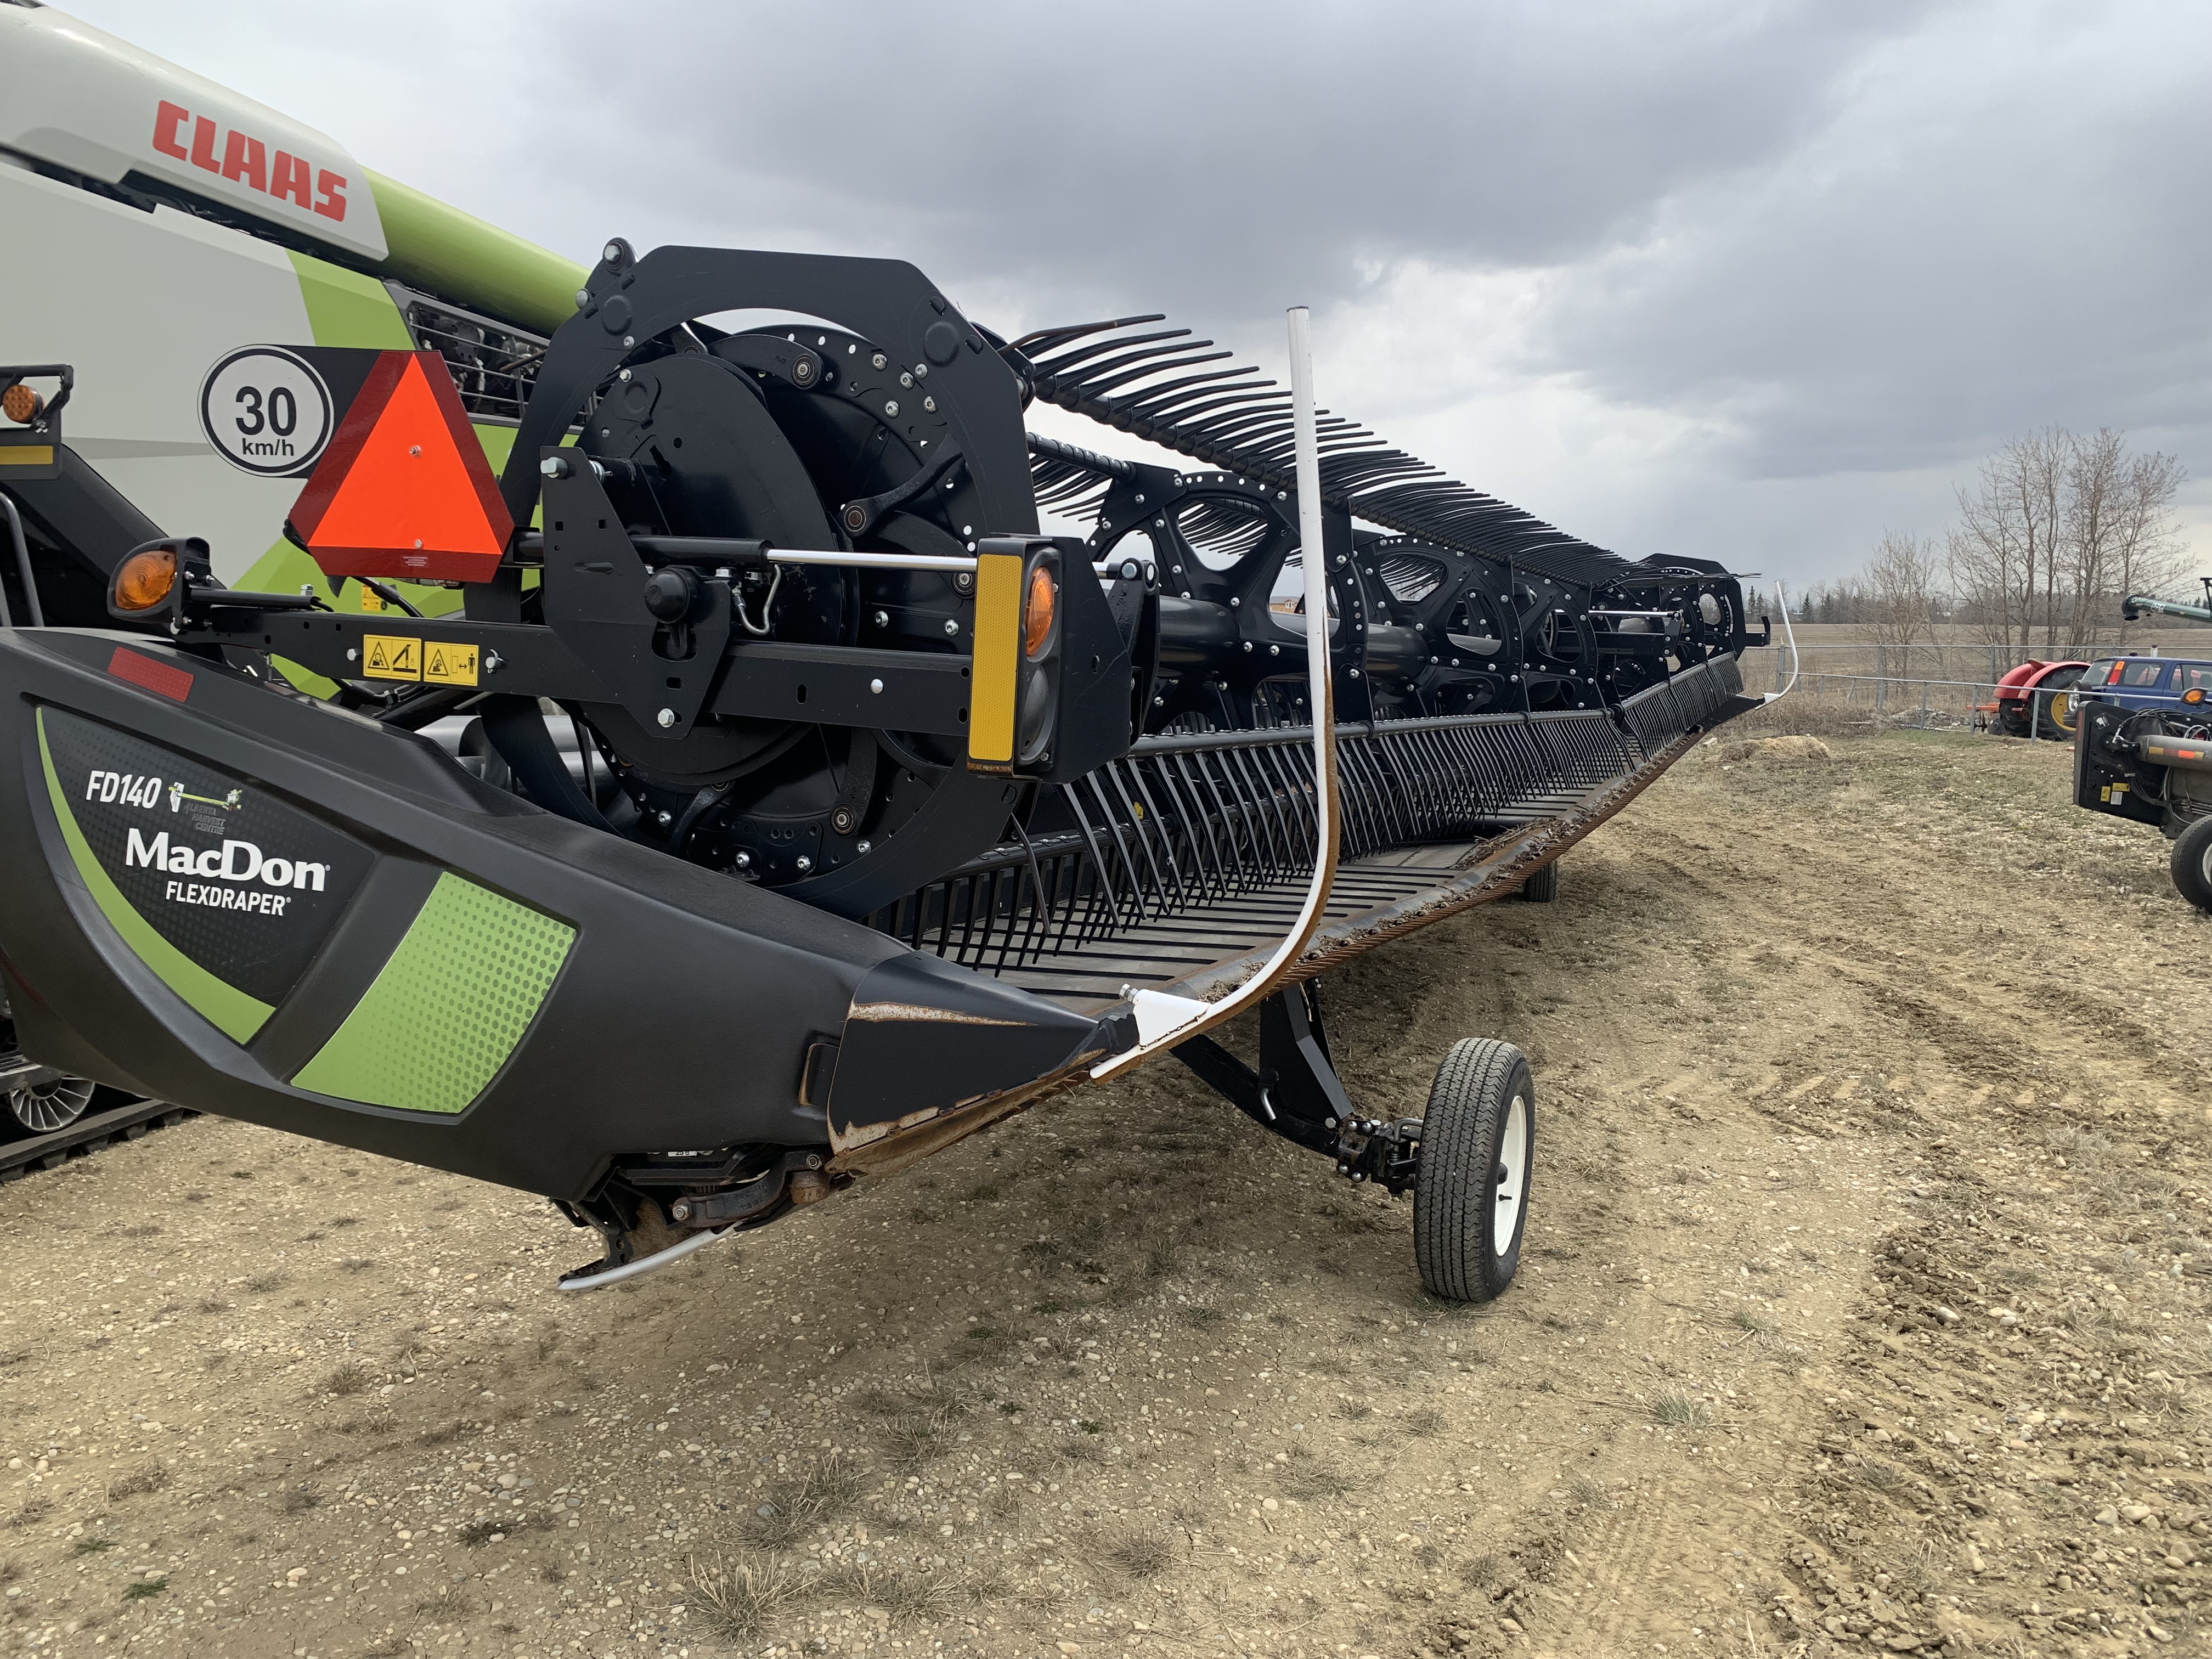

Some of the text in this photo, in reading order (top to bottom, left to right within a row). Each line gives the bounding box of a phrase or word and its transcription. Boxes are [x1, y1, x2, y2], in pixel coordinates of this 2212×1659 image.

[152, 100, 347, 222] CLAAS
[235, 386, 297, 436] 30
[242, 438, 295, 456] km/h
[86, 770, 162, 809] FD140
[184, 803, 216, 815] ALBERTA
[191, 812, 225, 826] HARVEST
[195, 822, 225, 834] CENTRE
[125, 827, 325, 891] MacDon
[166, 881, 285, 916] FLEXDRAPER
